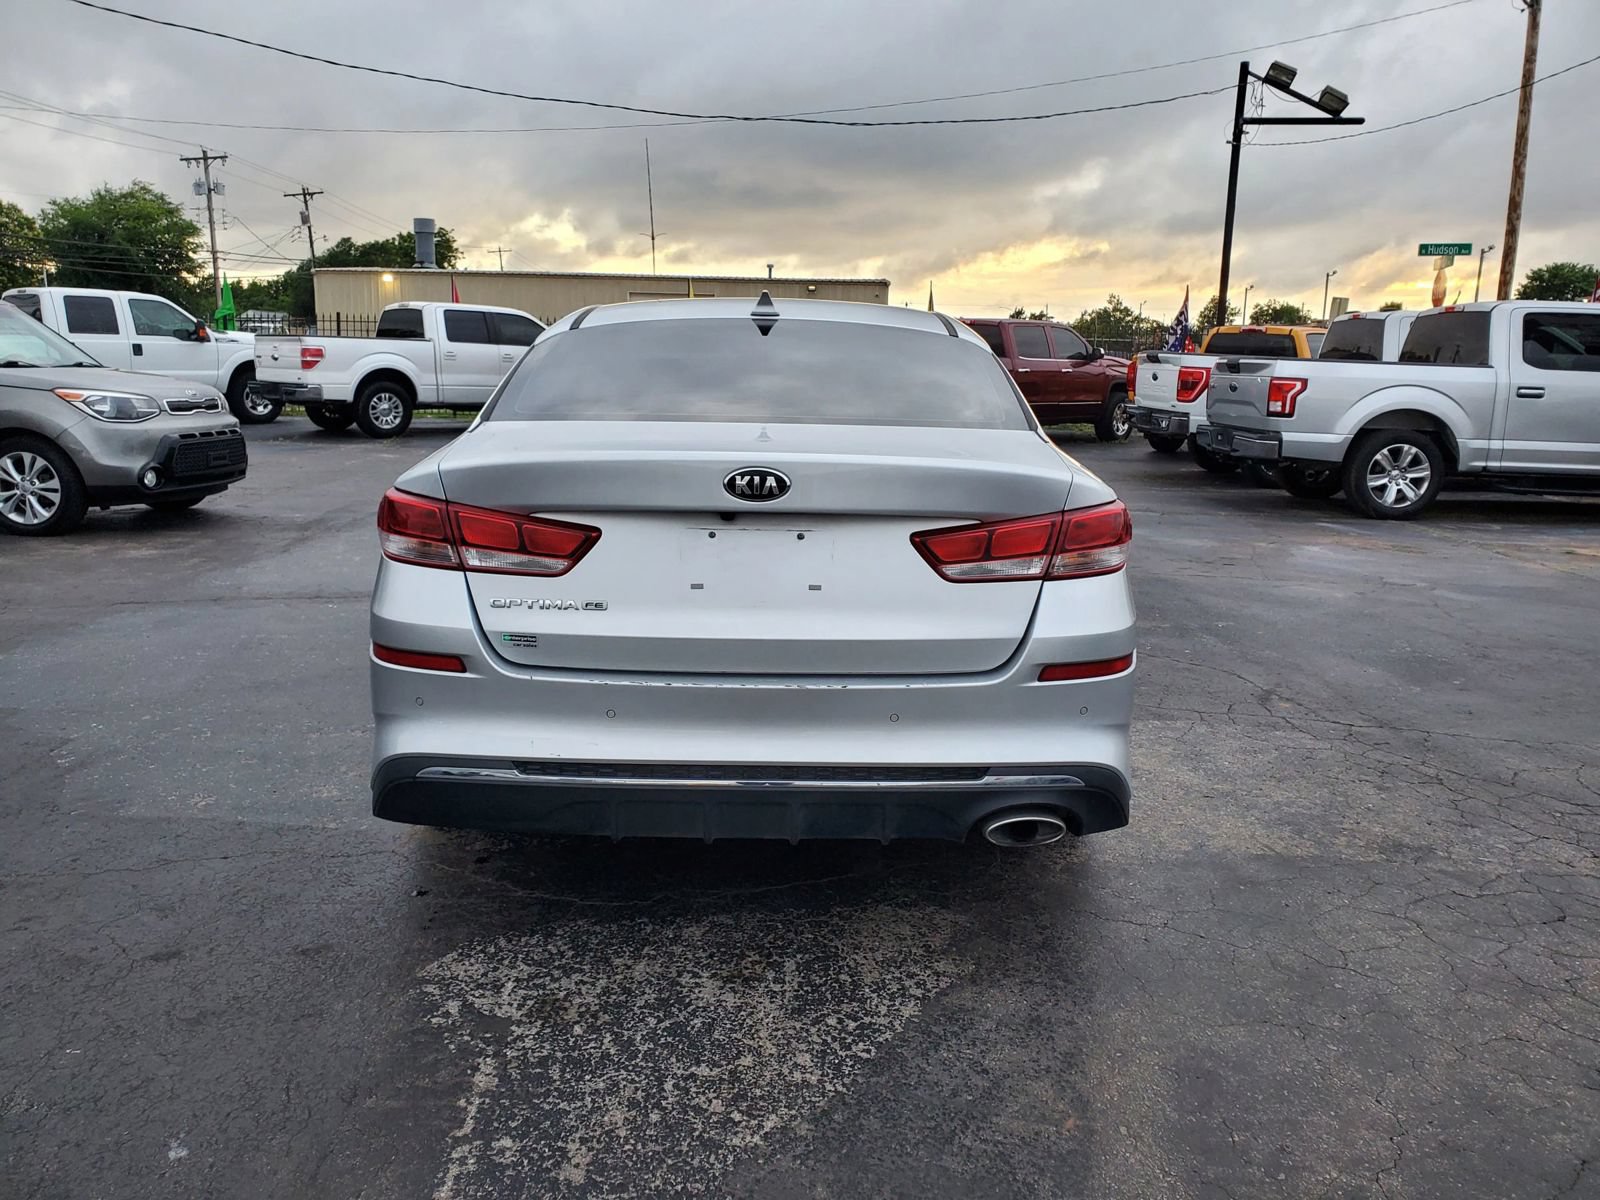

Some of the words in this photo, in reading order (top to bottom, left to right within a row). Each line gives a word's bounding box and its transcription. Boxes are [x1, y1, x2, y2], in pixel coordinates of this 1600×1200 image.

[1427, 244, 1459, 255] Hudson
[735, 475, 780, 495] KIA
[489, 598, 580, 611] OPTIMA
[584, 601, 605, 609] FE
